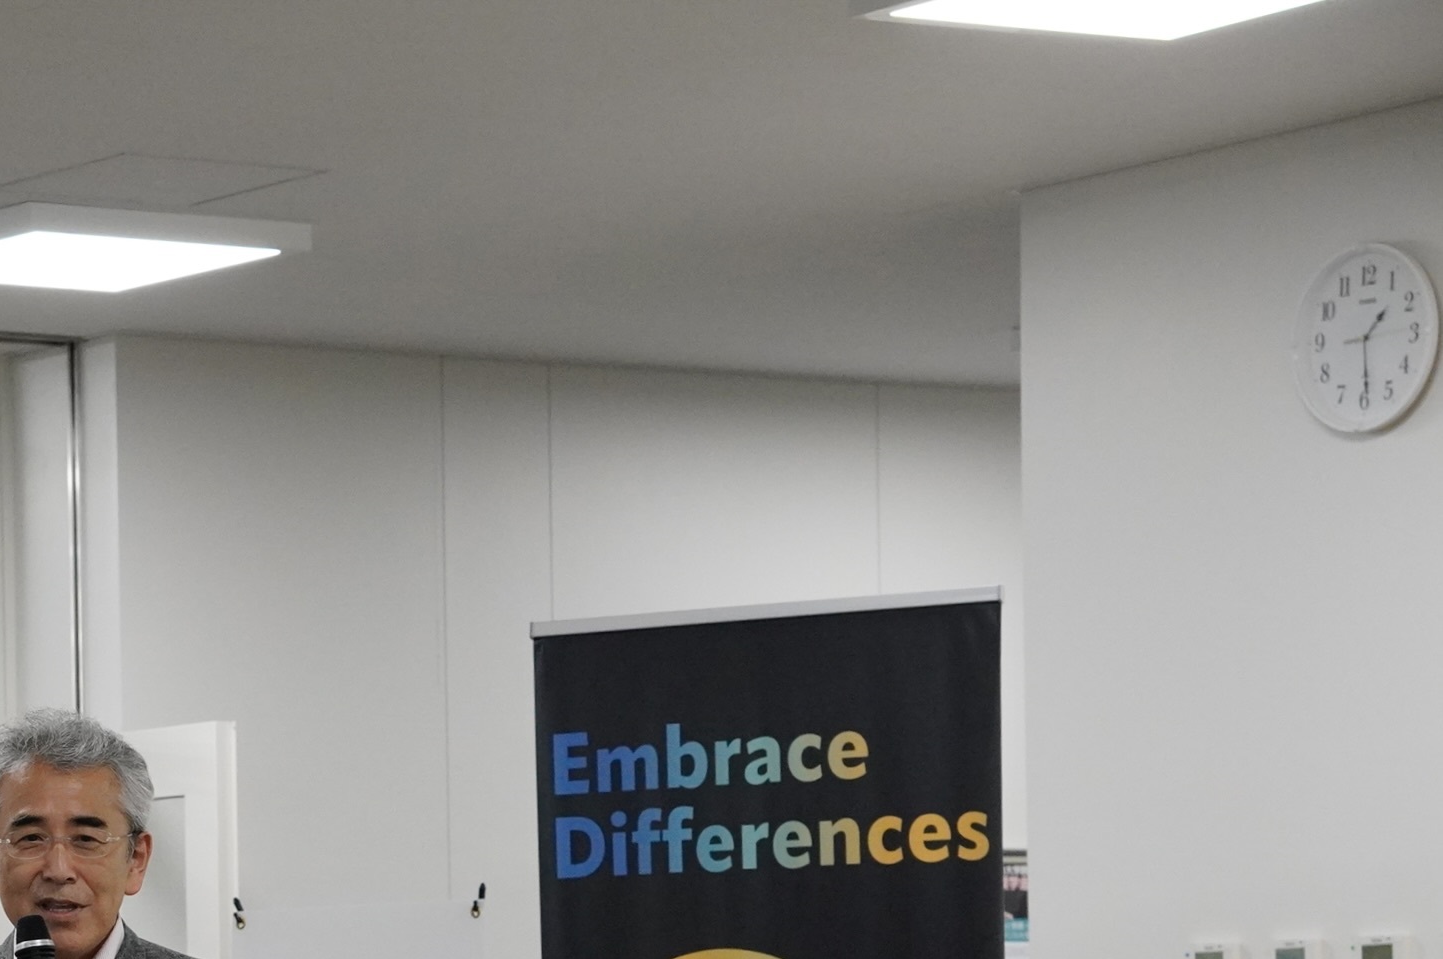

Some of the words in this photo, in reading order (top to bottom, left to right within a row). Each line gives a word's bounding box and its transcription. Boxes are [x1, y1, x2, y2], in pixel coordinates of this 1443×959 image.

[1361, 264, 1377, 287] 12
[1387, 270, 1396, 292] 1
[1338, 276, 1351, 298] 11
[1321, 301, 1336, 322] 10
[1404, 291, 1415, 312] 2
[1314, 333, 1325, 353] 9
[1408, 322, 1419, 344] 3
[1319, 363, 1330, 384] 8
[1399, 354, 1409, 375] 4
[1337, 384, 1347, 405] 7
[1359, 391, 1370, 410] 6
[1383, 380, 1393, 401] 5
[552, 723, 870, 796] Embrace
[554, 806, 991, 880] Differences
